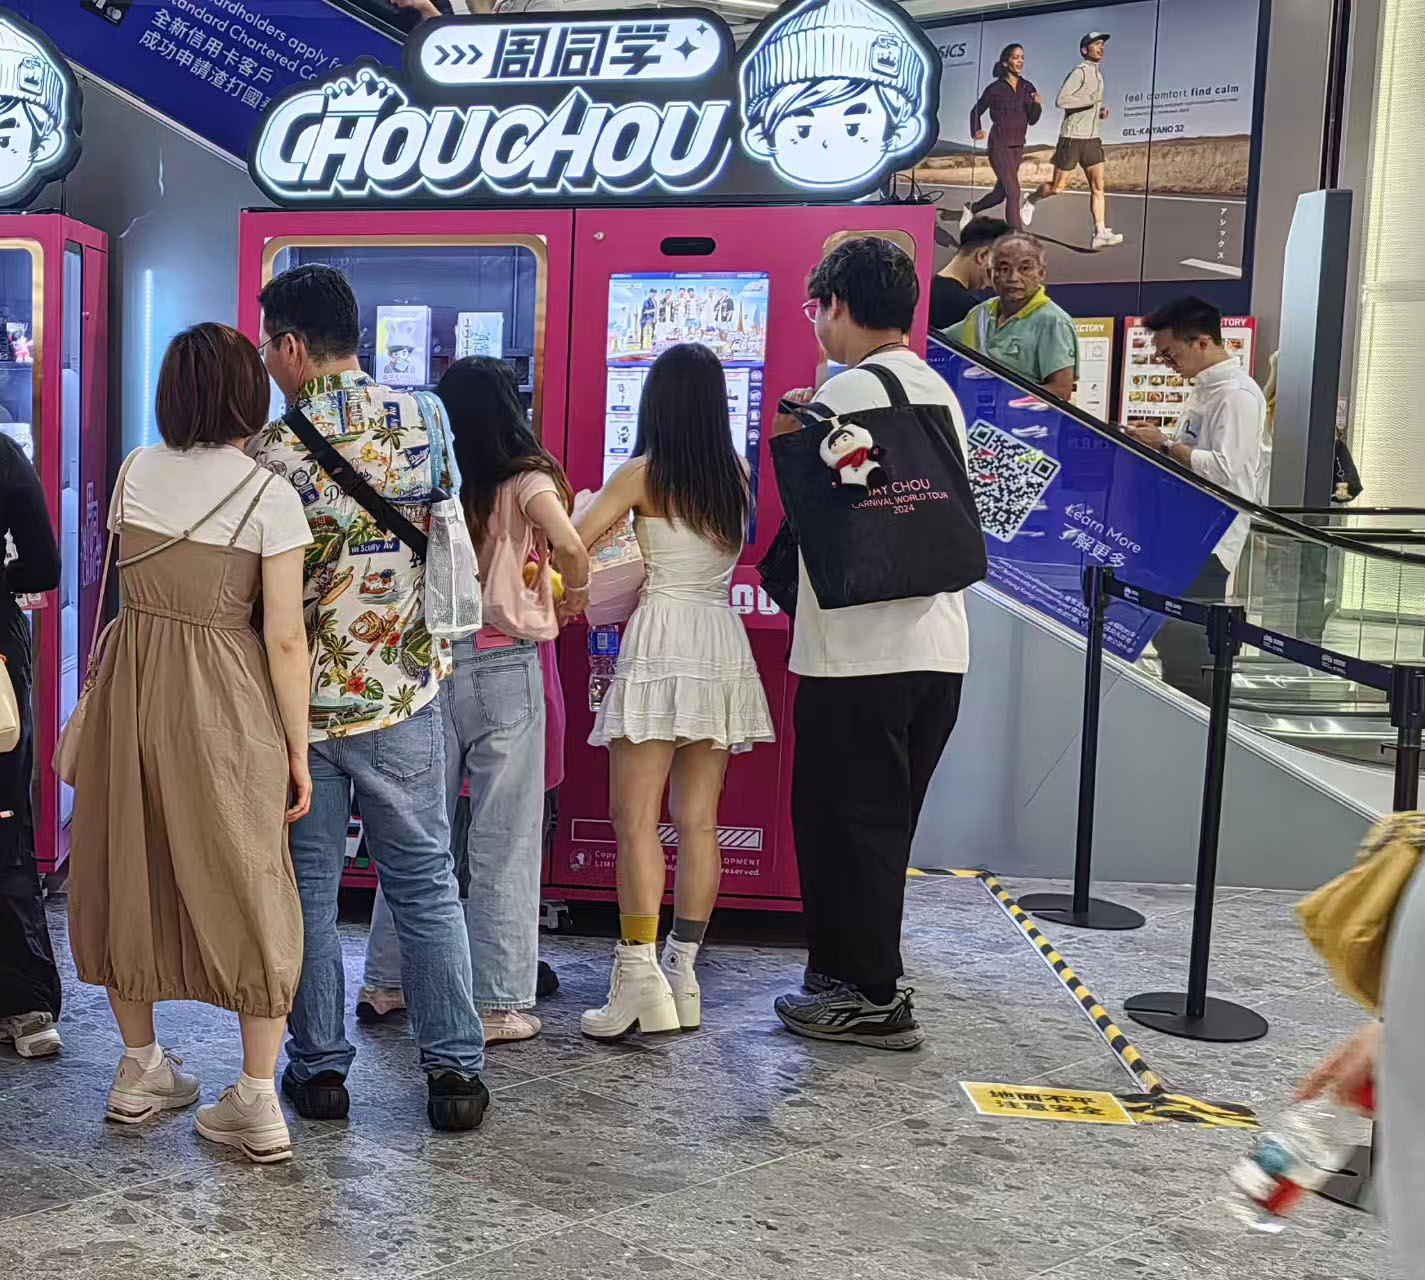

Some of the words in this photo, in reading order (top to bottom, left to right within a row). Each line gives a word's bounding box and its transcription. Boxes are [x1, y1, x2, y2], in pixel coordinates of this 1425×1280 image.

[168, 0, 227, 32] tandard
[229, 24, 296, 72] Chartered
[212, 0, 286, 42] ardholders
[288, 36, 328, 64] apply
[483, 23, 671, 79] 周同学
[938, 42, 967, 58] SICS
[1124, 92, 1143, 103] feel
[1146, 89, 1187, 100] comfort
[1190, 86, 1211, 97] find
[1214, 84, 1239, 94] calm
[1122, 126, 1174, 136] GEL-KAYANO
[1174, 124, 1185, 133] 32
[255, 86, 731, 197] CHOUCHOU
[869, 485, 888, 496] AY
[891, 478, 931, 493] CHOU
[894, 493, 926, 504] WORLD
[926, 491, 949, 500] TOUR
[893, 504, 915, 514] 2024
[1065, 504, 1104, 533] Learn
[1106, 527, 1141, 554] More
[1059, 523, 1126, 568] 了解更多
[594, 850, 616, 860] Copy
[723, 857, 761, 866] OPMENT
